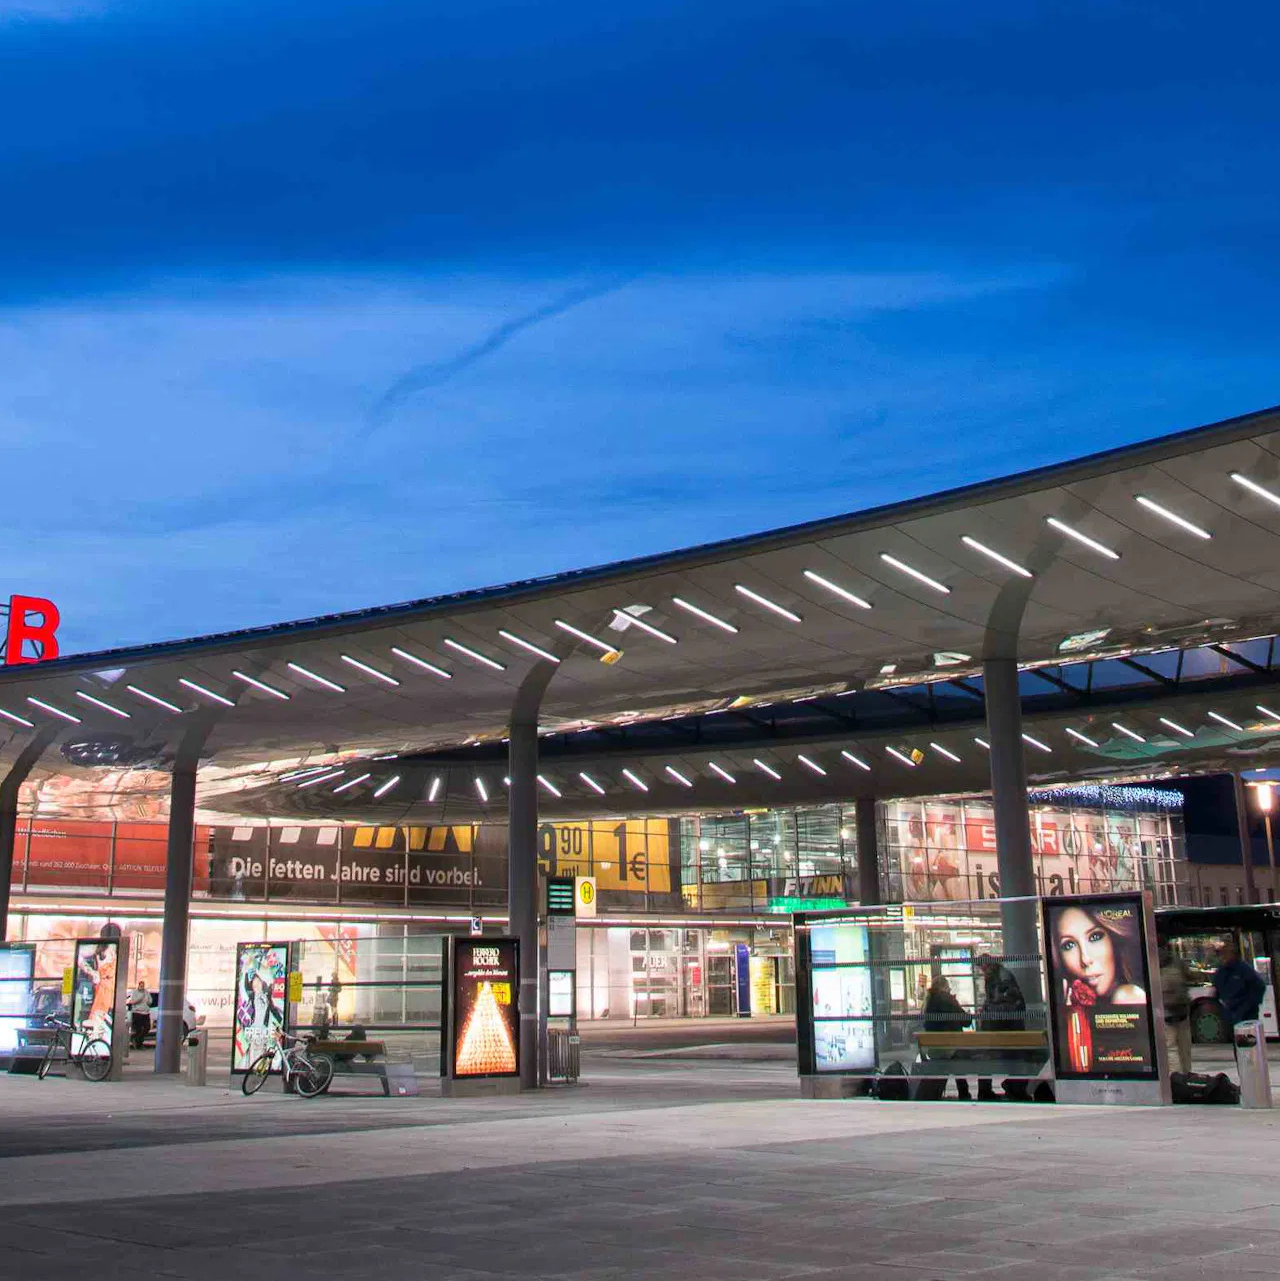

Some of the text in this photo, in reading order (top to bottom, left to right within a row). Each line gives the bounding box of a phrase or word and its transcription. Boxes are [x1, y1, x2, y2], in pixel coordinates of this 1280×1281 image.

[231, 856, 483, 886] Die fetten Jahre sind vorbei.
